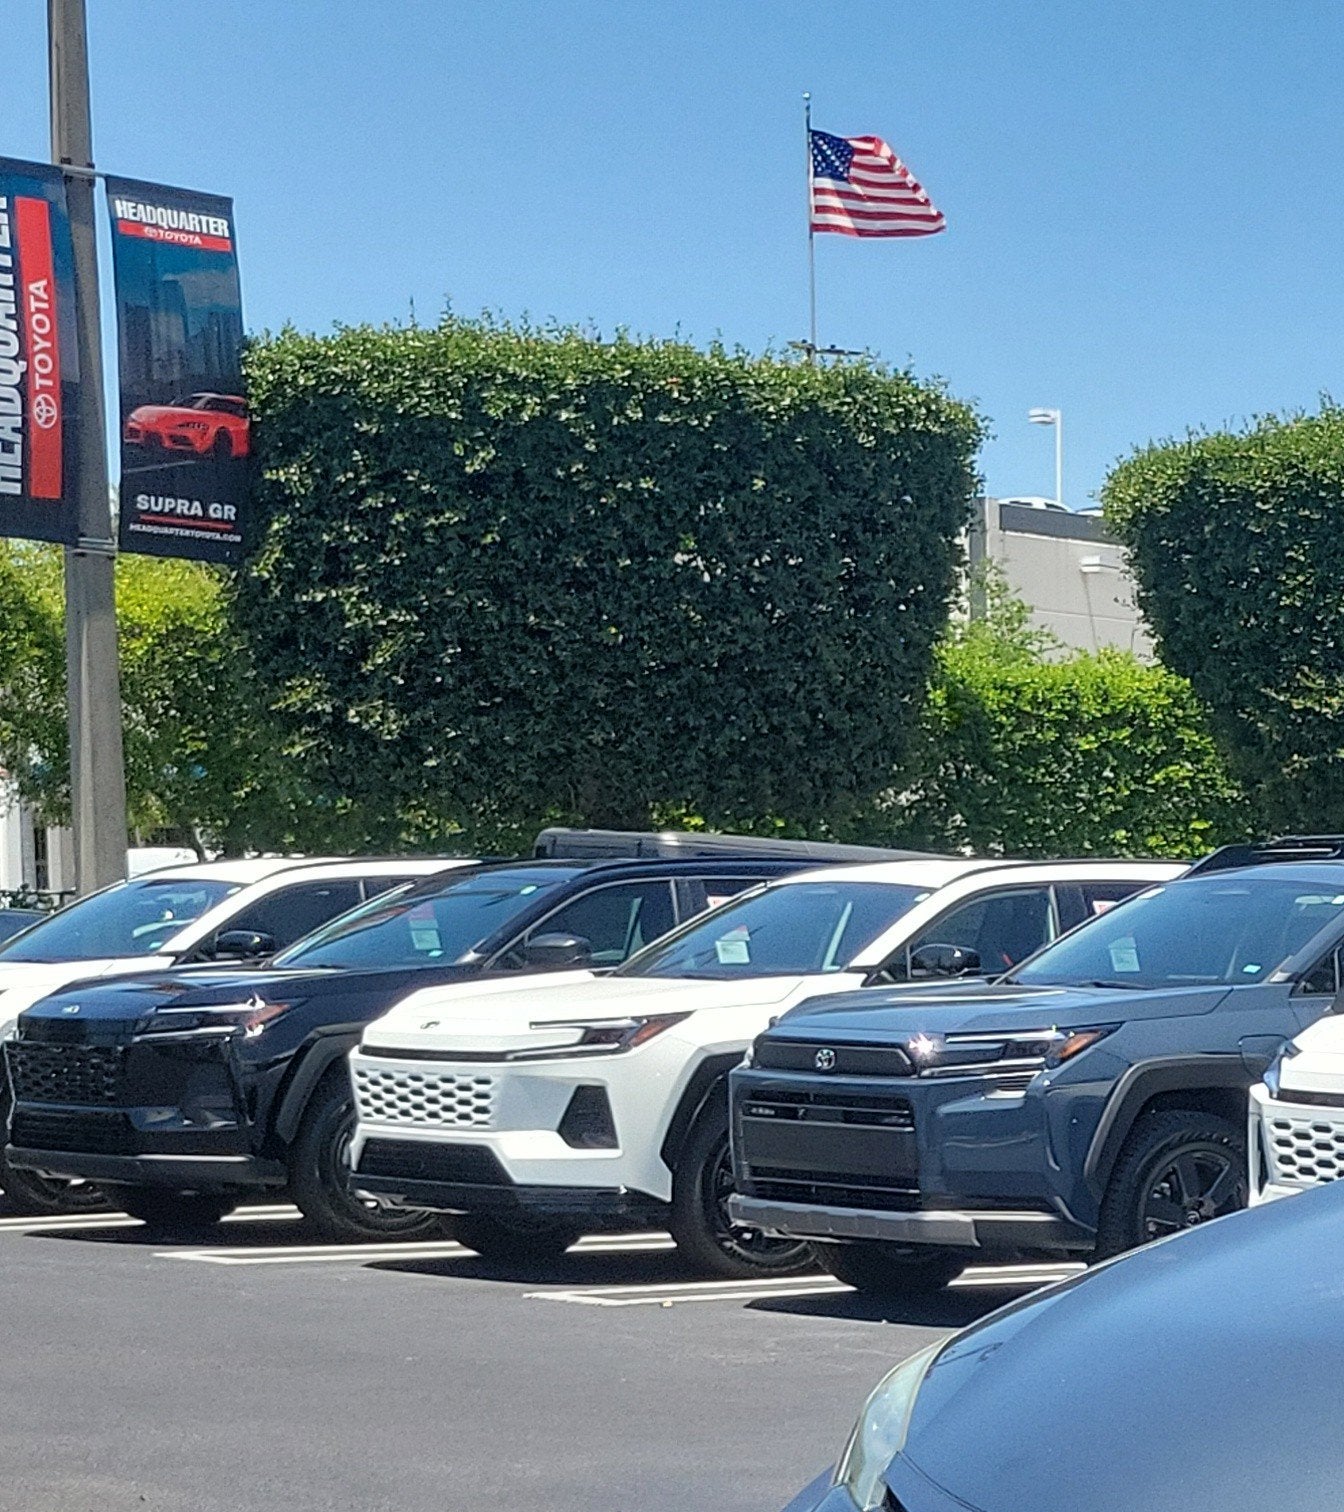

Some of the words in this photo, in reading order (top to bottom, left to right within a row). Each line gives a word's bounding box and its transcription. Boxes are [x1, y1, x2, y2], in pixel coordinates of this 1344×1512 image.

[115, 199, 230, 238] HEADQUARTER
[159, 228, 203, 246] TOYOTA
[30, 278, 54, 390] TOYOTA
[136, 493, 203, 517] SUPRA
[208, 502, 237, 520] GR
